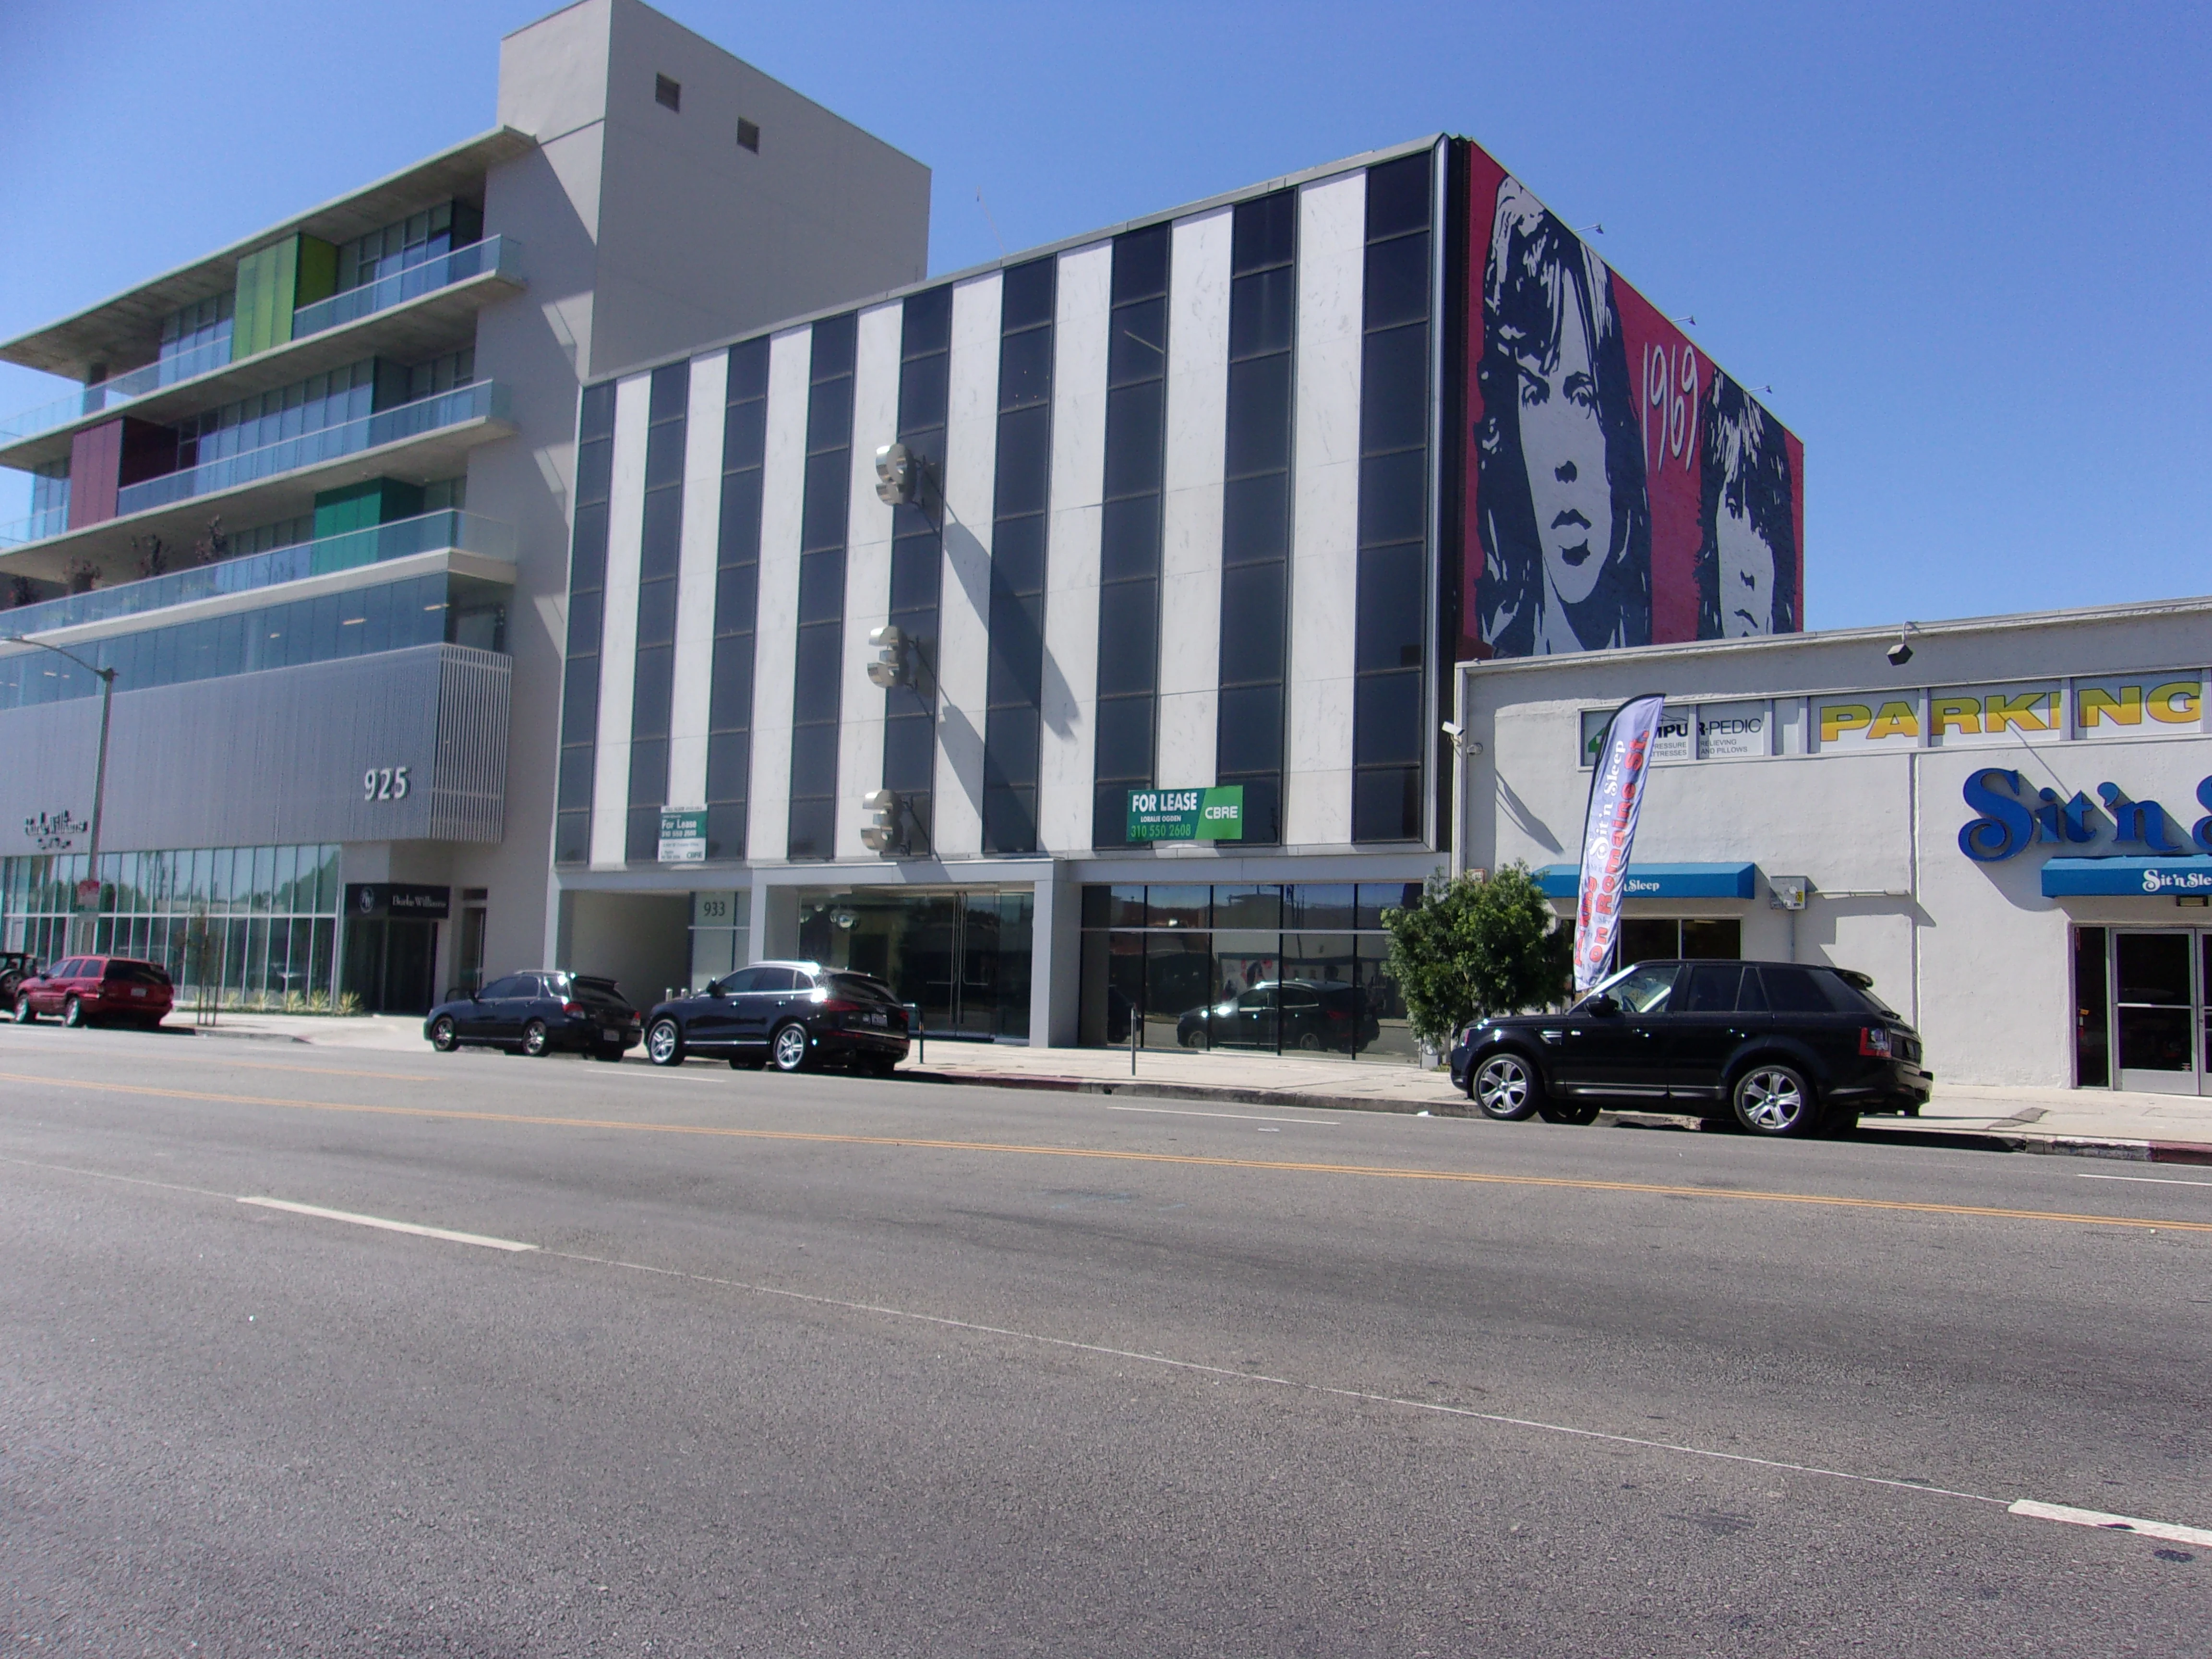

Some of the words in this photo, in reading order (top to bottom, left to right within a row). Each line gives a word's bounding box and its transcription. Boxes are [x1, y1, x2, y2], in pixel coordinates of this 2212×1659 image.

[1643, 341, 1698, 476] 1969
[1820, 681, 2201, 742] PARKING
[1604, 740, 1625, 797] Sleep
[364, 767, 407, 801] 925
[1132, 794, 1157, 812] FOR
[1160, 792, 1197, 811] LEASE
[1205, 806, 1238, 819] CBRE
[661, 819, 674, 830] For
[677, 818, 697, 829] Lease
[1131, 825, 1147, 837] 310
[1150, 825, 1166, 837] 550
[1169, 824, 1191, 836] 2608
[1628, 879, 1659, 892] Sleep
[2187, 873, 2212, 888] Sle
[704, 902, 725, 916] 933
[1589, 927, 1609, 962] on
